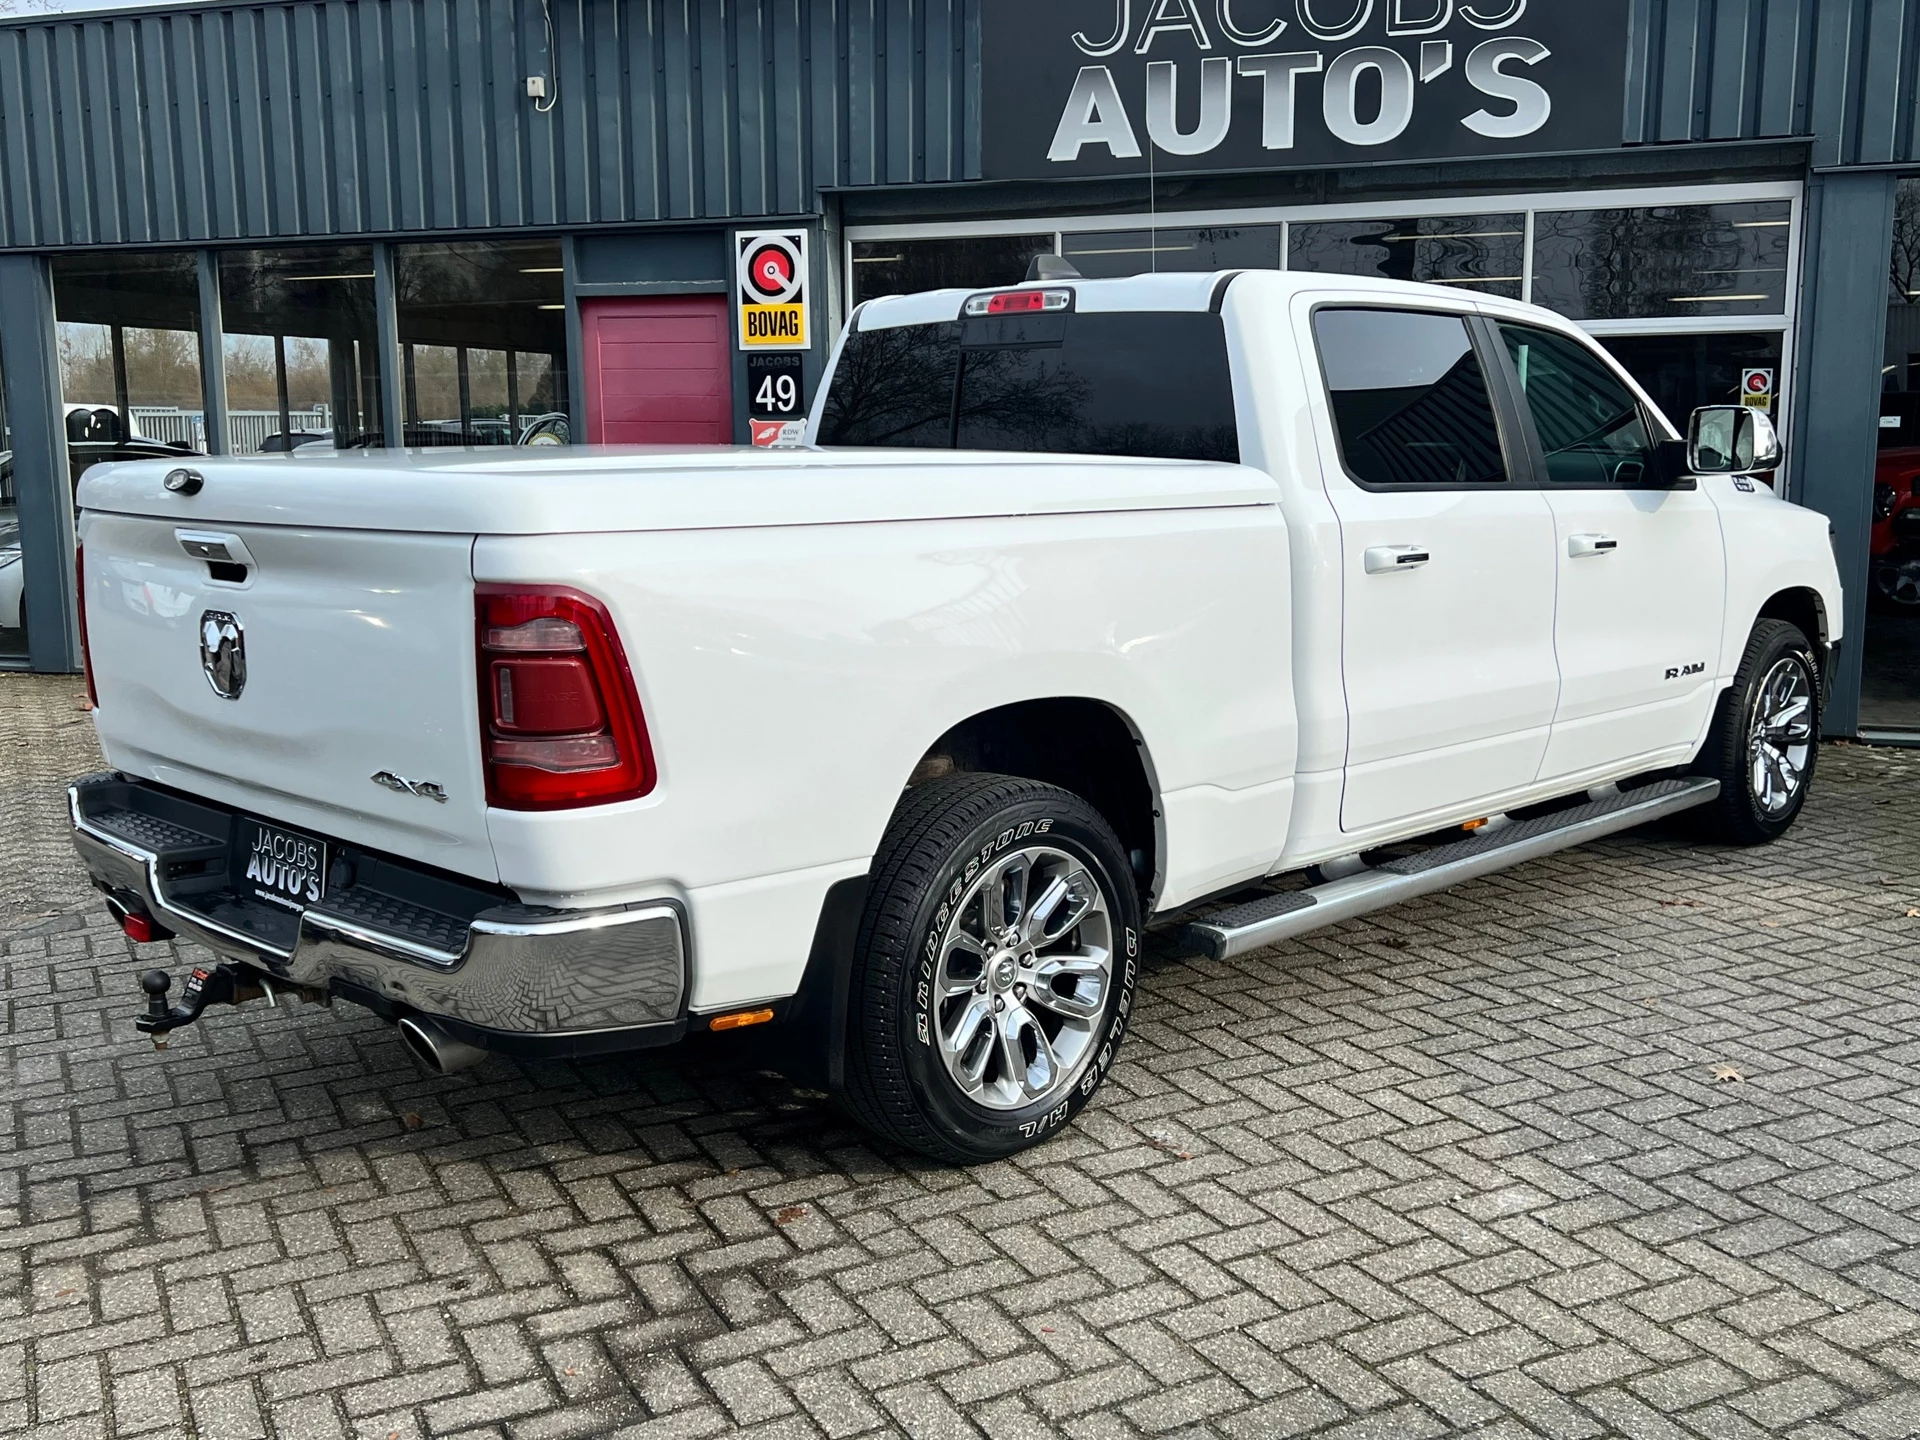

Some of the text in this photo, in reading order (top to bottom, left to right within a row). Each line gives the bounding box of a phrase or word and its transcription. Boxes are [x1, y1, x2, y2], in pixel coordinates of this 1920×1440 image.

[1047, 36, 1552, 162] AUTO'S
[748, 310, 799, 337] BOVAG
[750, 356, 800, 367] JACOBS
[755, 375, 796, 412] 49
[1745, 397, 1767, 407] BOVAG
[1664, 661, 1705, 680] RAM
[251, 827, 318, 871] JACOBS
[246, 851, 320, 903] AUTO'S
[916, 818, 1054, 1047] BRIDGESTONE
[1081, 926, 1138, 1096] DUELER
